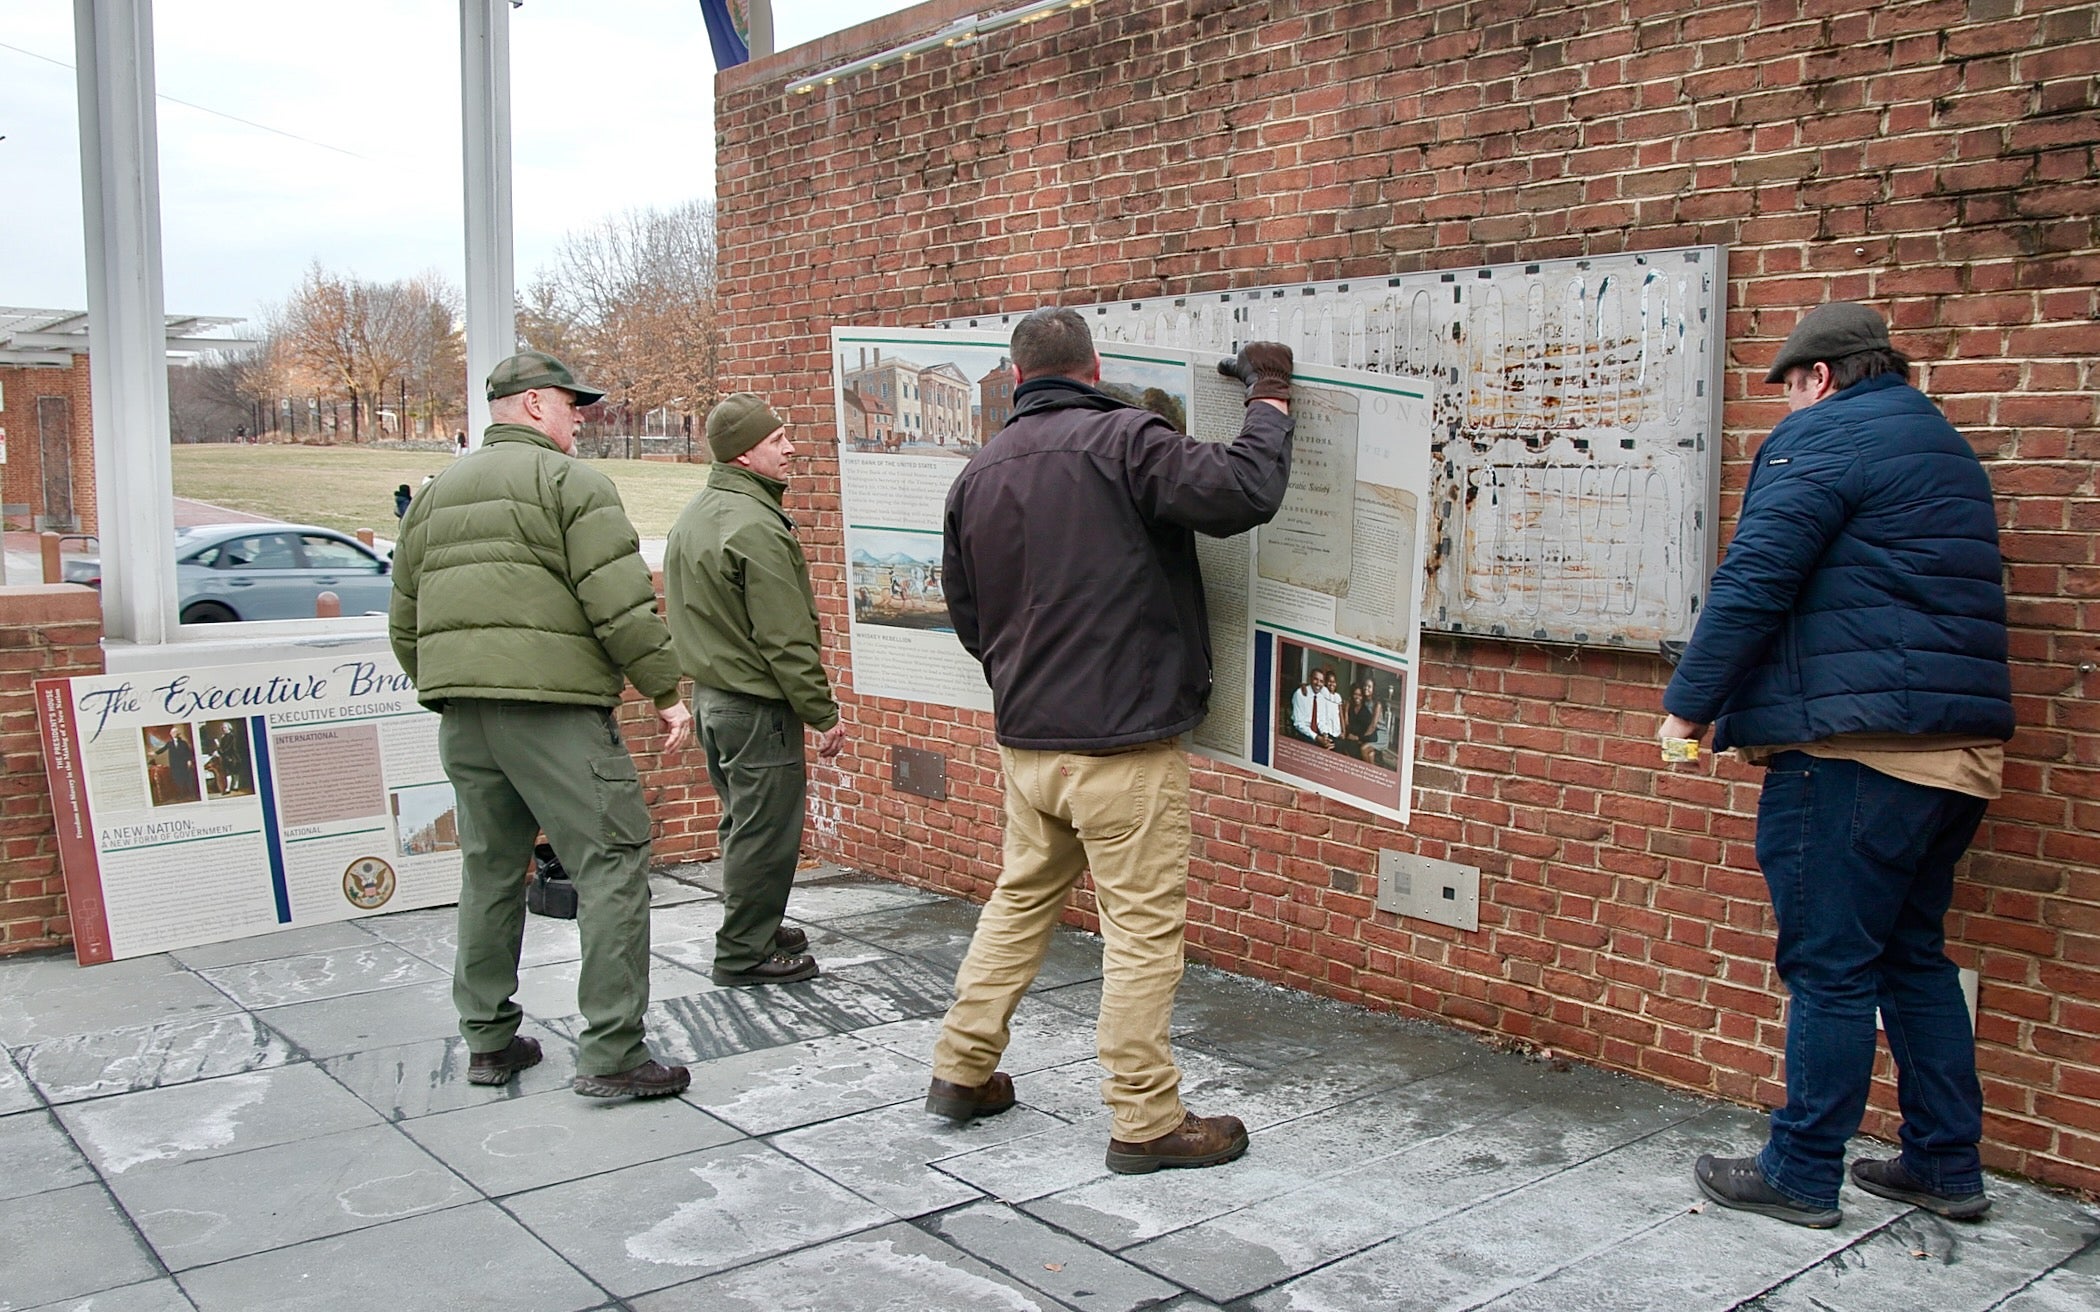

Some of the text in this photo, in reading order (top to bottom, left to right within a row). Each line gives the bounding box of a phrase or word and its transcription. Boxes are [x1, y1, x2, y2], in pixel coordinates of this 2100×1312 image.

[1373, 396, 1430, 427] ONS
[79, 661, 416, 744] The Executive Bra
[270, 701, 402, 724] EXECUTIVE DECISIONS
[275, 731, 339, 745] INTERNATIONAL
[101, 824, 233, 849] A NEW FORM OF GOVERNMENT
[102, 819, 195, 840] A NEW NATION:
[284, 826, 322, 838] NATIONAL
